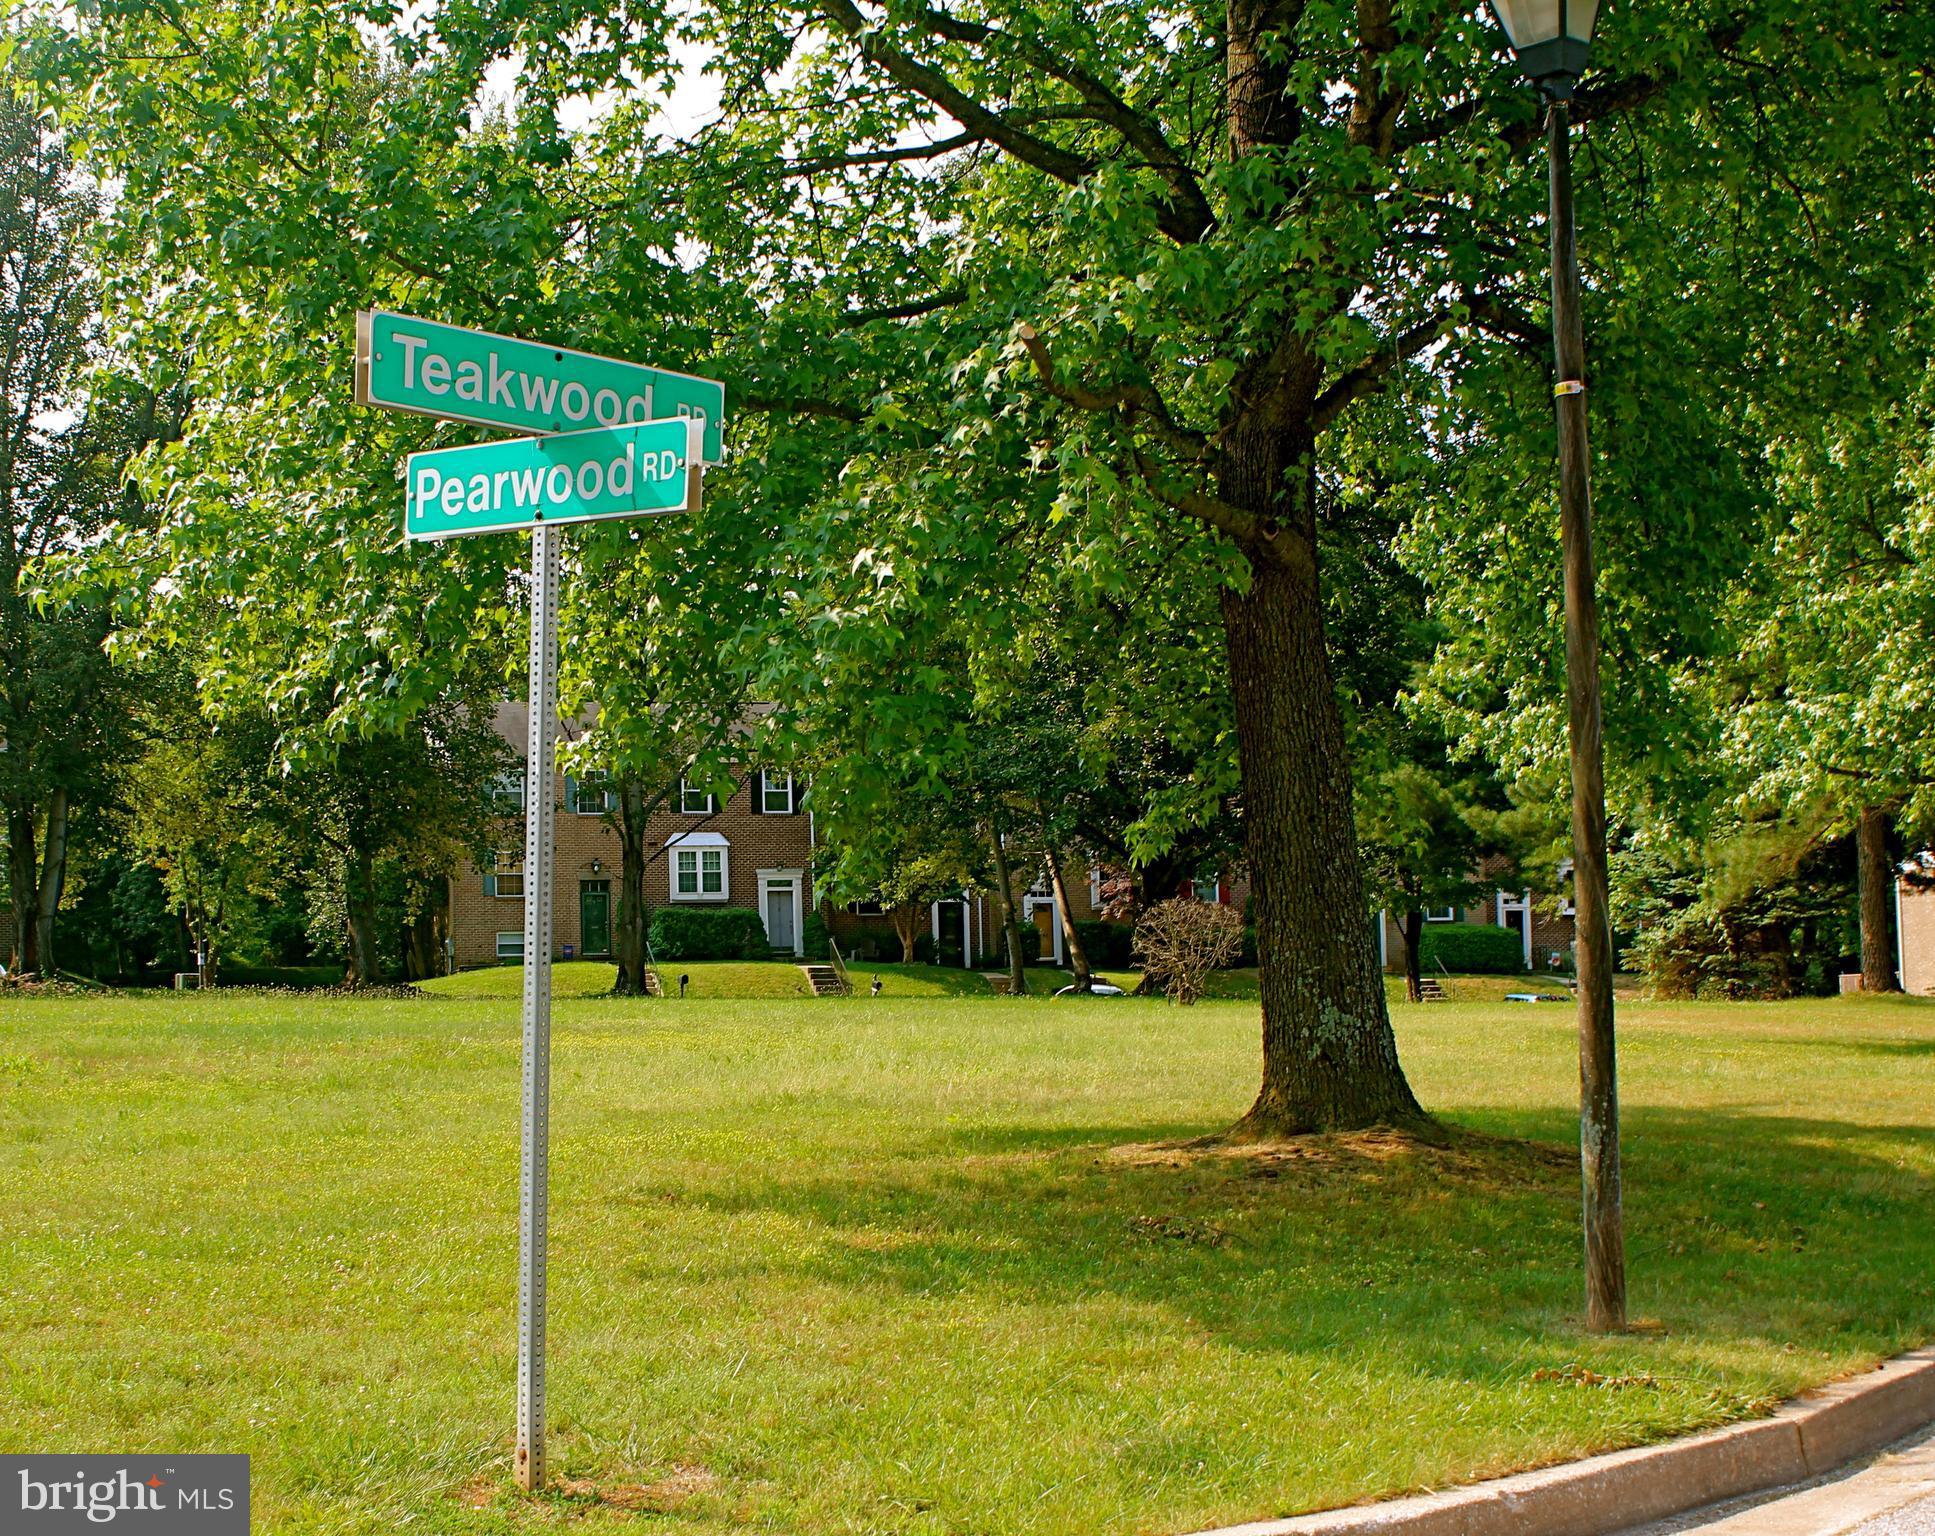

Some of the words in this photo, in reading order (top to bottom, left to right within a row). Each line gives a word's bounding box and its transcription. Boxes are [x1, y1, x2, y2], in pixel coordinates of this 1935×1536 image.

[392, 333, 653, 425] Teakwood
[416, 442, 635, 518] Pearwood
[643, 450, 676, 481] RD
